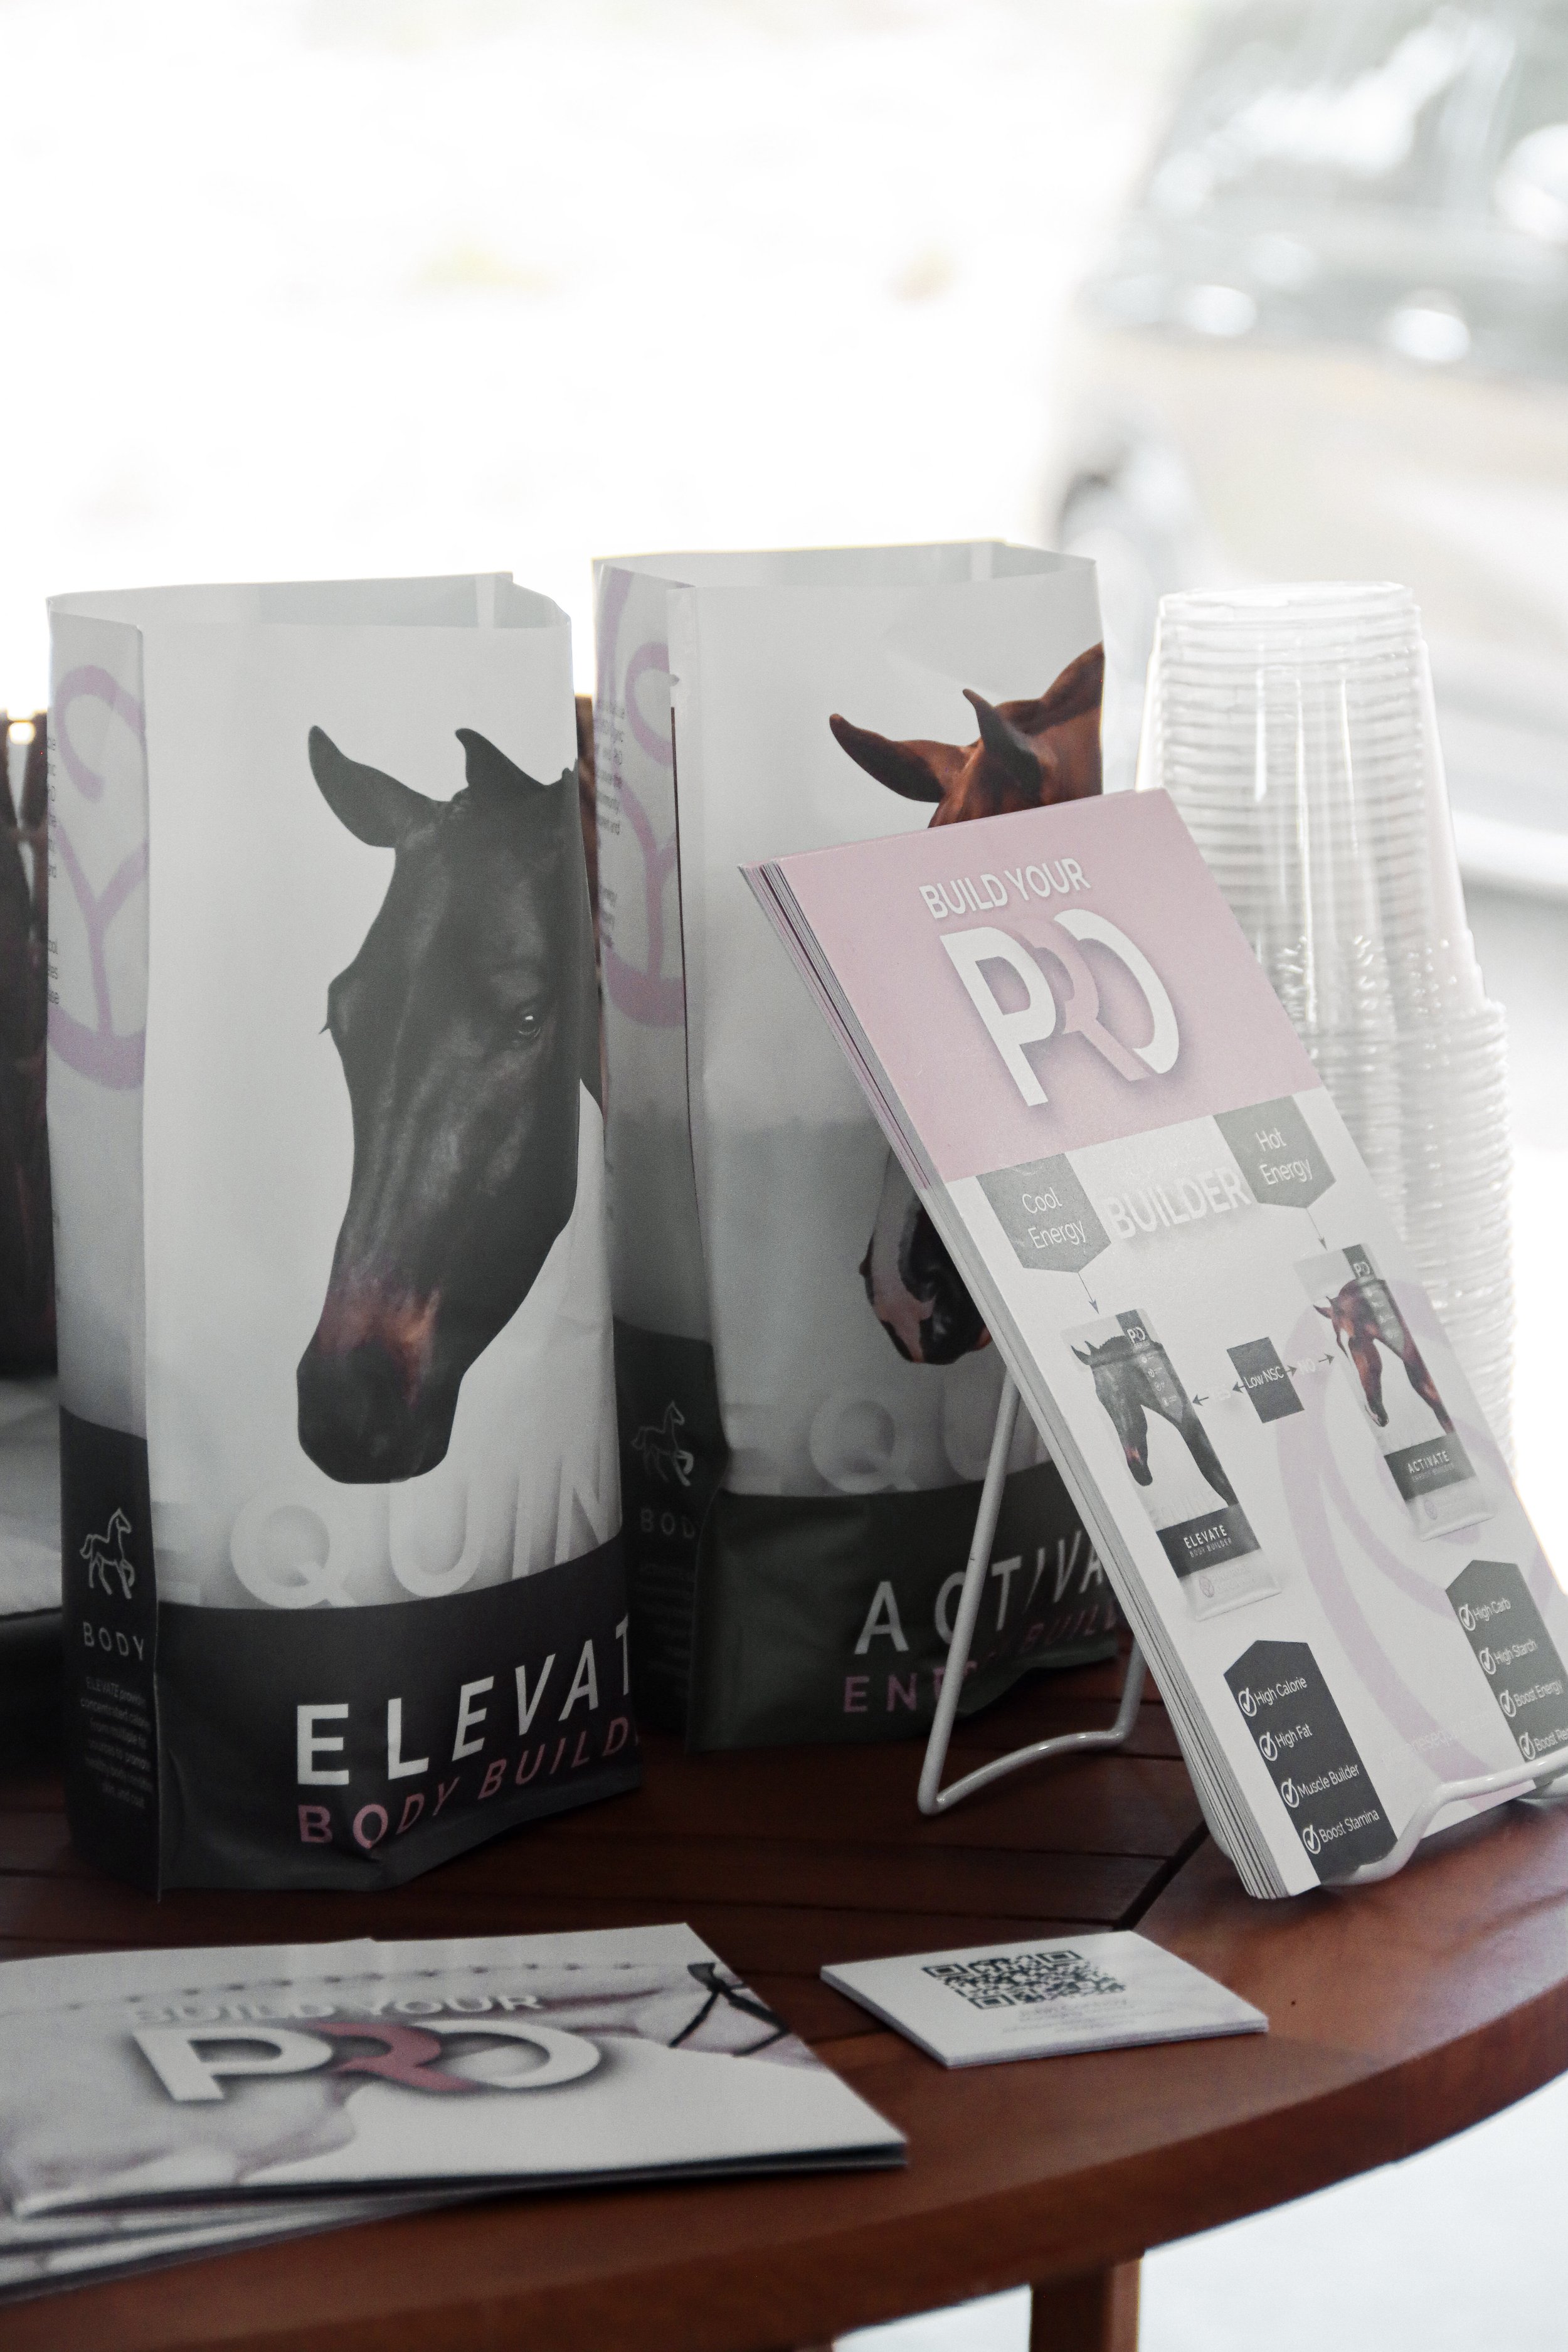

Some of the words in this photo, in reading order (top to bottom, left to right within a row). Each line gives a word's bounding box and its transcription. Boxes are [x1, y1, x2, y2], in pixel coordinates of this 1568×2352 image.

[919, 874, 1008, 918] BUILD
[1004, 857, 1091, 901] YOUR
[940, 908, 1179, 1107] PRO
[1256, 1128, 1286, 1152] Hot
[1259, 1157, 1312, 1185] Energy
[1022, 1187, 1062, 1214] Cool
[1102, 1167, 1252, 1239] BUILDER
[1028, 1220, 1087, 1250] Energy
[1242, 1374, 1264, 1389] Low
[1263, 1366, 1285, 1383] NSC
[1296, 1358, 1316, 1375] NO
[1407, 1451, 1450, 1474] ACTIVATE
[1183, 1524, 1228, 1550] ELEVATE
[1473, 1604, 1493, 1622] High
[1491, 1597, 1512, 1614] Carb
[82, 1620, 145, 1661] BODY
[1493, 1648, 1515, 1665] High
[1512, 1639, 1538, 1658] Starch
[1255, 1686, 1277, 1706] High
[1276, 1677, 1308, 1697] Calorie
[1513, 1688, 1538, 1707] Boost
[1535, 1681, 1564, 1698] Energy
[1274, 1730, 1297, 1749] High
[1296, 1724, 1313, 1740] Fat
[1534, 1732, 1559, 1752] Boost
[297, 1777, 460, 1849] BODY
[477, 1715, 639, 1801] BUILD
[1297, 1776, 1330, 1799] Muscle
[1328, 1764, 1360, 1785] Builder
[1319, 1823, 1345, 1843] Boost
[1344, 1808, 1380, 1832] Stamina
[130, 2018, 601, 2102] PRO
